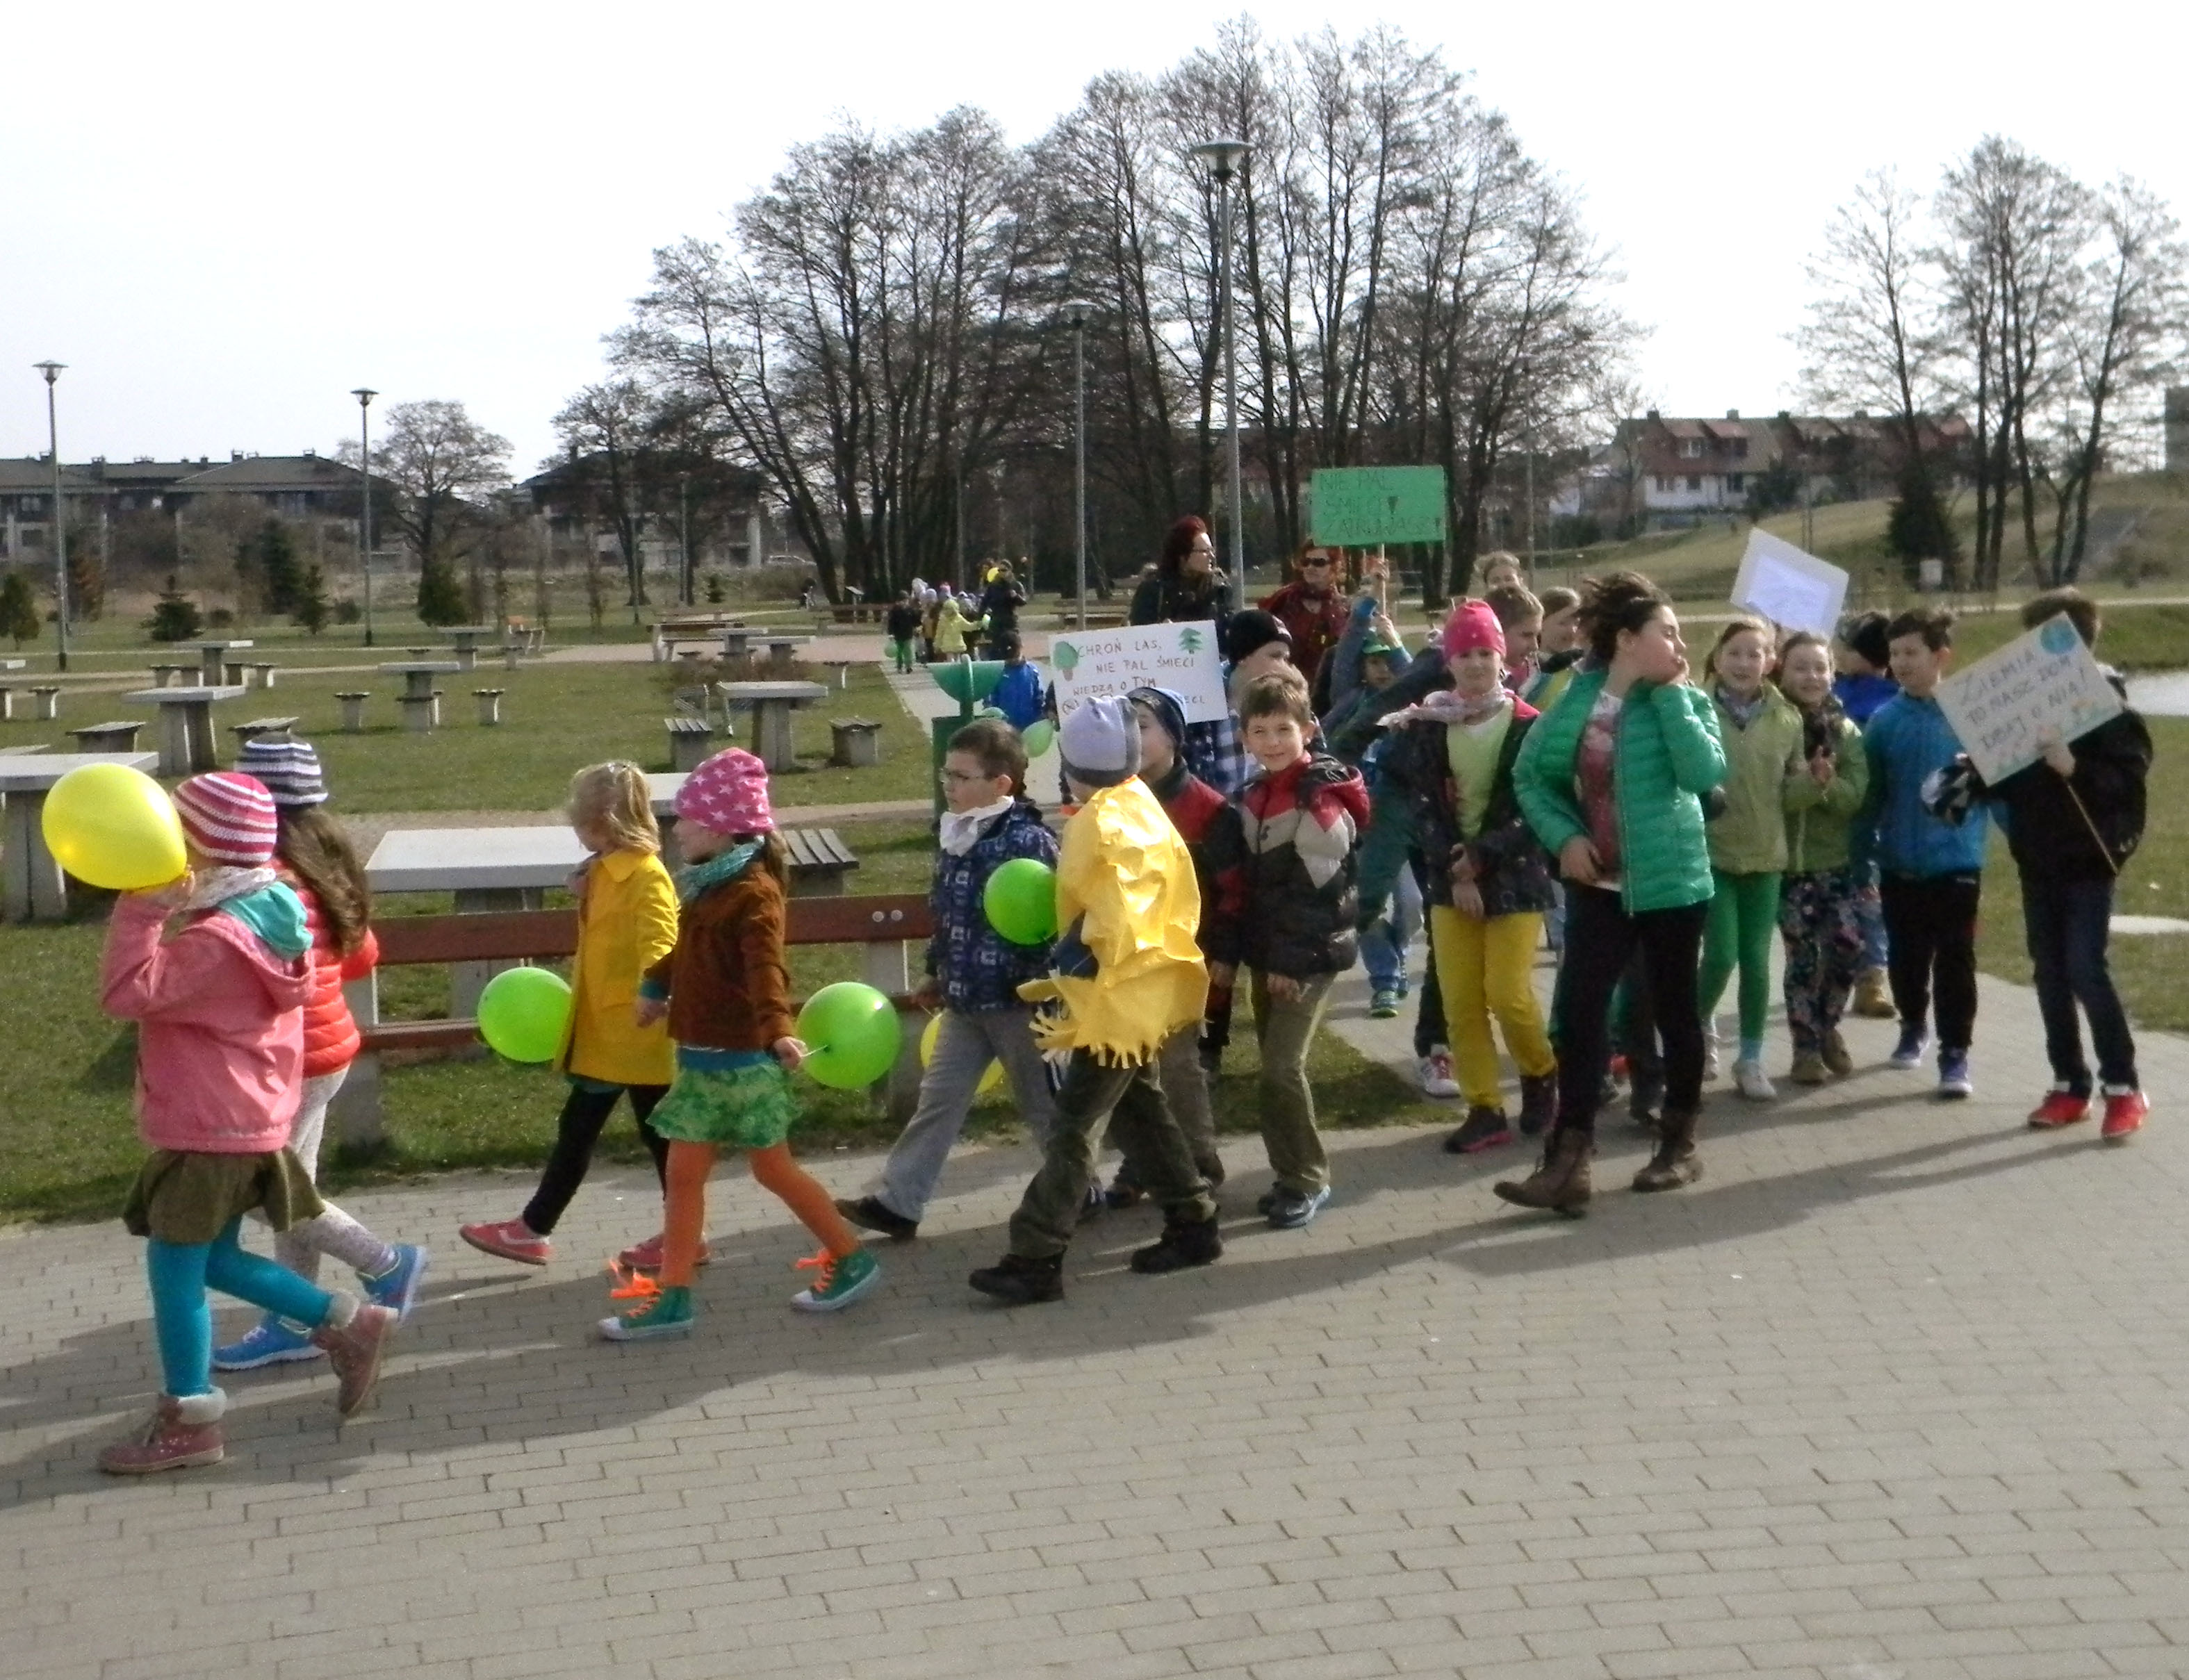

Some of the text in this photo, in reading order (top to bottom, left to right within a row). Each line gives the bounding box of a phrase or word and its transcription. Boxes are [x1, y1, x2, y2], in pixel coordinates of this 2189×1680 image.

[1078, 636, 1122, 657] CHROŃ
[1096, 655, 1194, 673] NIE PAL ŚMIECI
[1120, 681, 1126, 690] O
[1131, 675, 1156, 688] TYM
[1965, 705, 1986, 725] TO
[1990, 678, 2035, 709] NASZ
[2031, 705, 2042, 720] O
